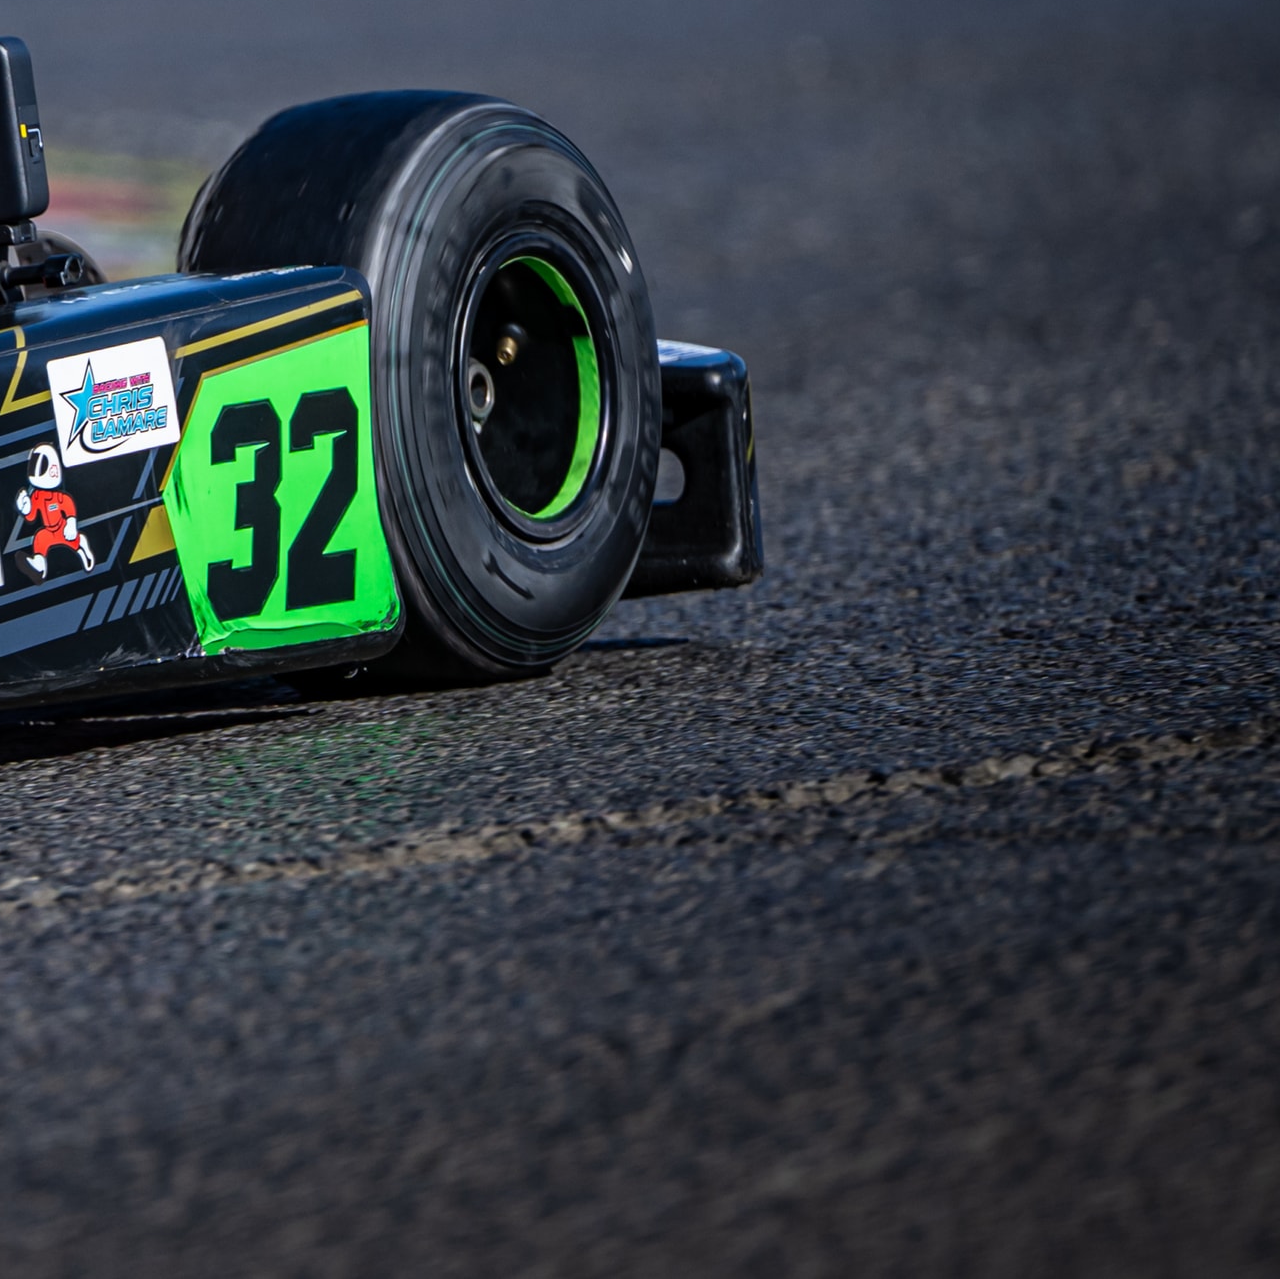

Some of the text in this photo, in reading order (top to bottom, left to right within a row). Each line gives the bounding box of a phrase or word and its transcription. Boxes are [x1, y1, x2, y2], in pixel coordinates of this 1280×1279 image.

[87, 384, 154, 421] CHRIS
[91, 405, 168, 443] LAMARE
[207, 386, 360, 622] 32
